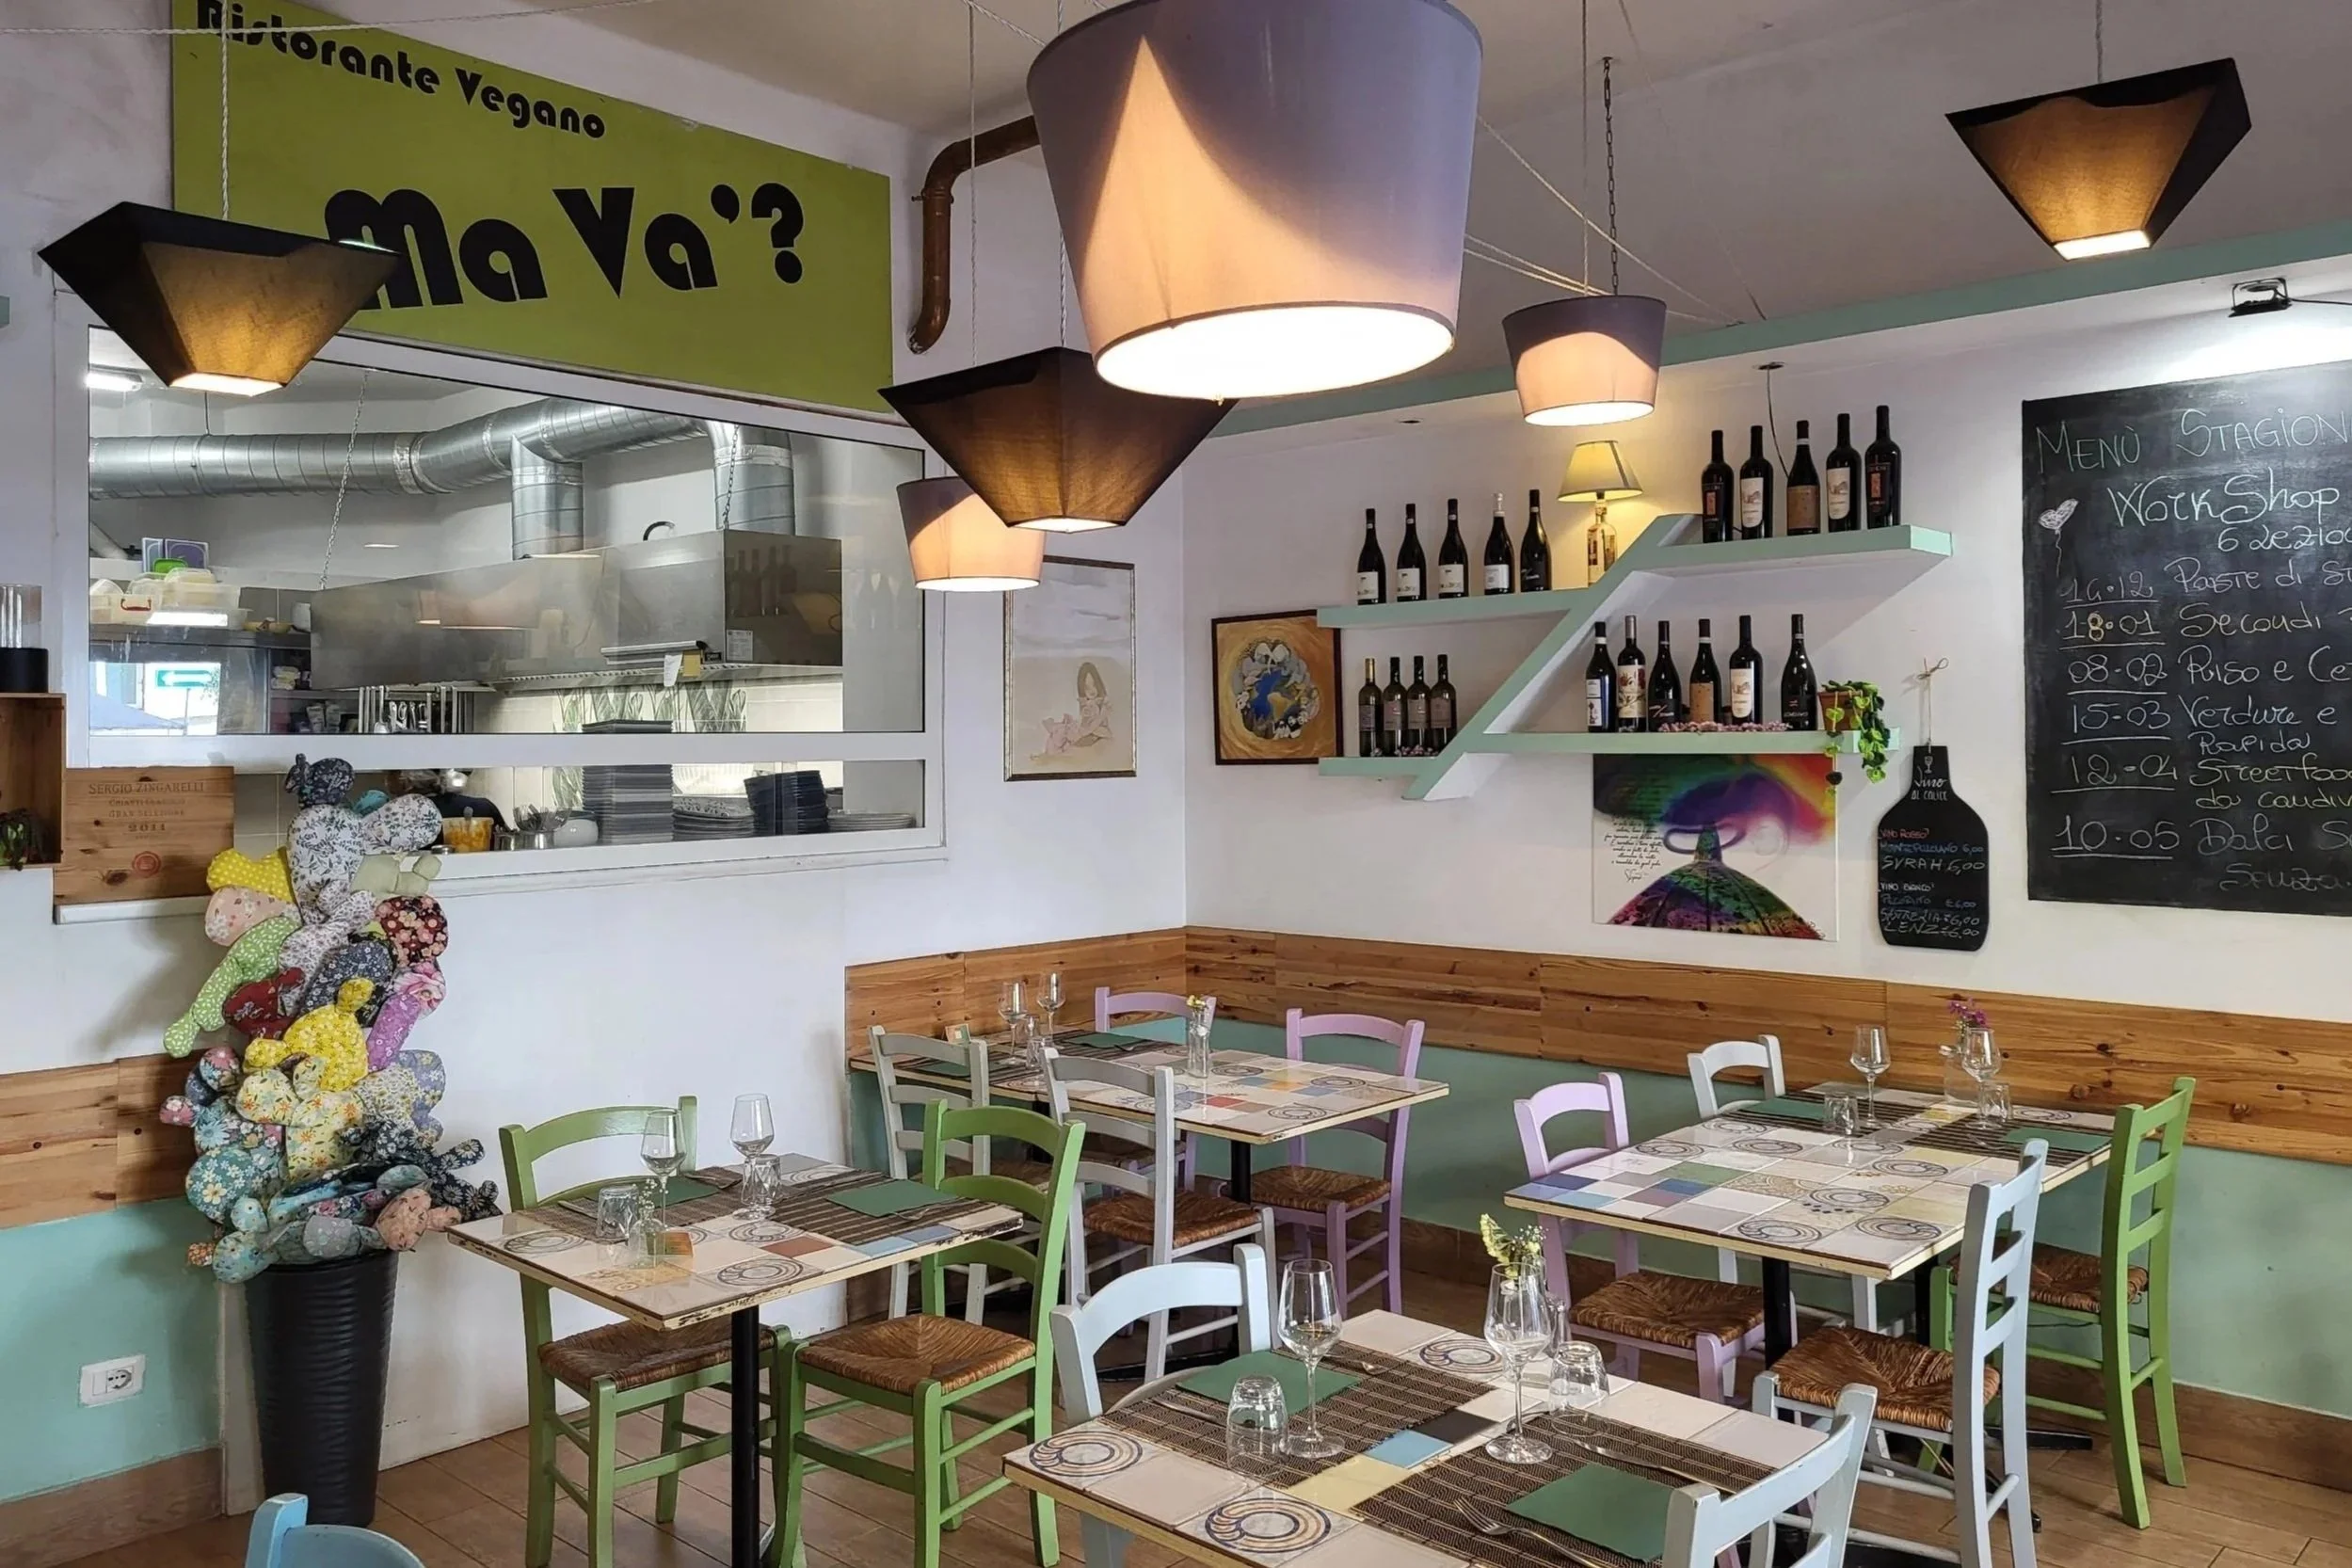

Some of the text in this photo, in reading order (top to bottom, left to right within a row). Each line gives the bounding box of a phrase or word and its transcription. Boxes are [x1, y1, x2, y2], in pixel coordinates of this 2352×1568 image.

[197, 0, 605, 138] Ristorante Vegano
[325, 188, 548, 310] Ma
[2218, 527, 2239, 552] 6
[2276, 559, 2302, 586] di
[2178, 645, 2260, 684] Riso
[2274, 661, 2294, 681] e
[2309, 645, 2352, 682] Ce
[2178, 695, 2302, 728] Verdure
[2317, 707, 2337, 725] e
[88, 782, 204, 794] SERGIO ZINGARELLI
[2196, 788, 2241, 809] da
[128, 824, 166, 832] 2011
[1881, 855, 1943, 871] SYRAH
